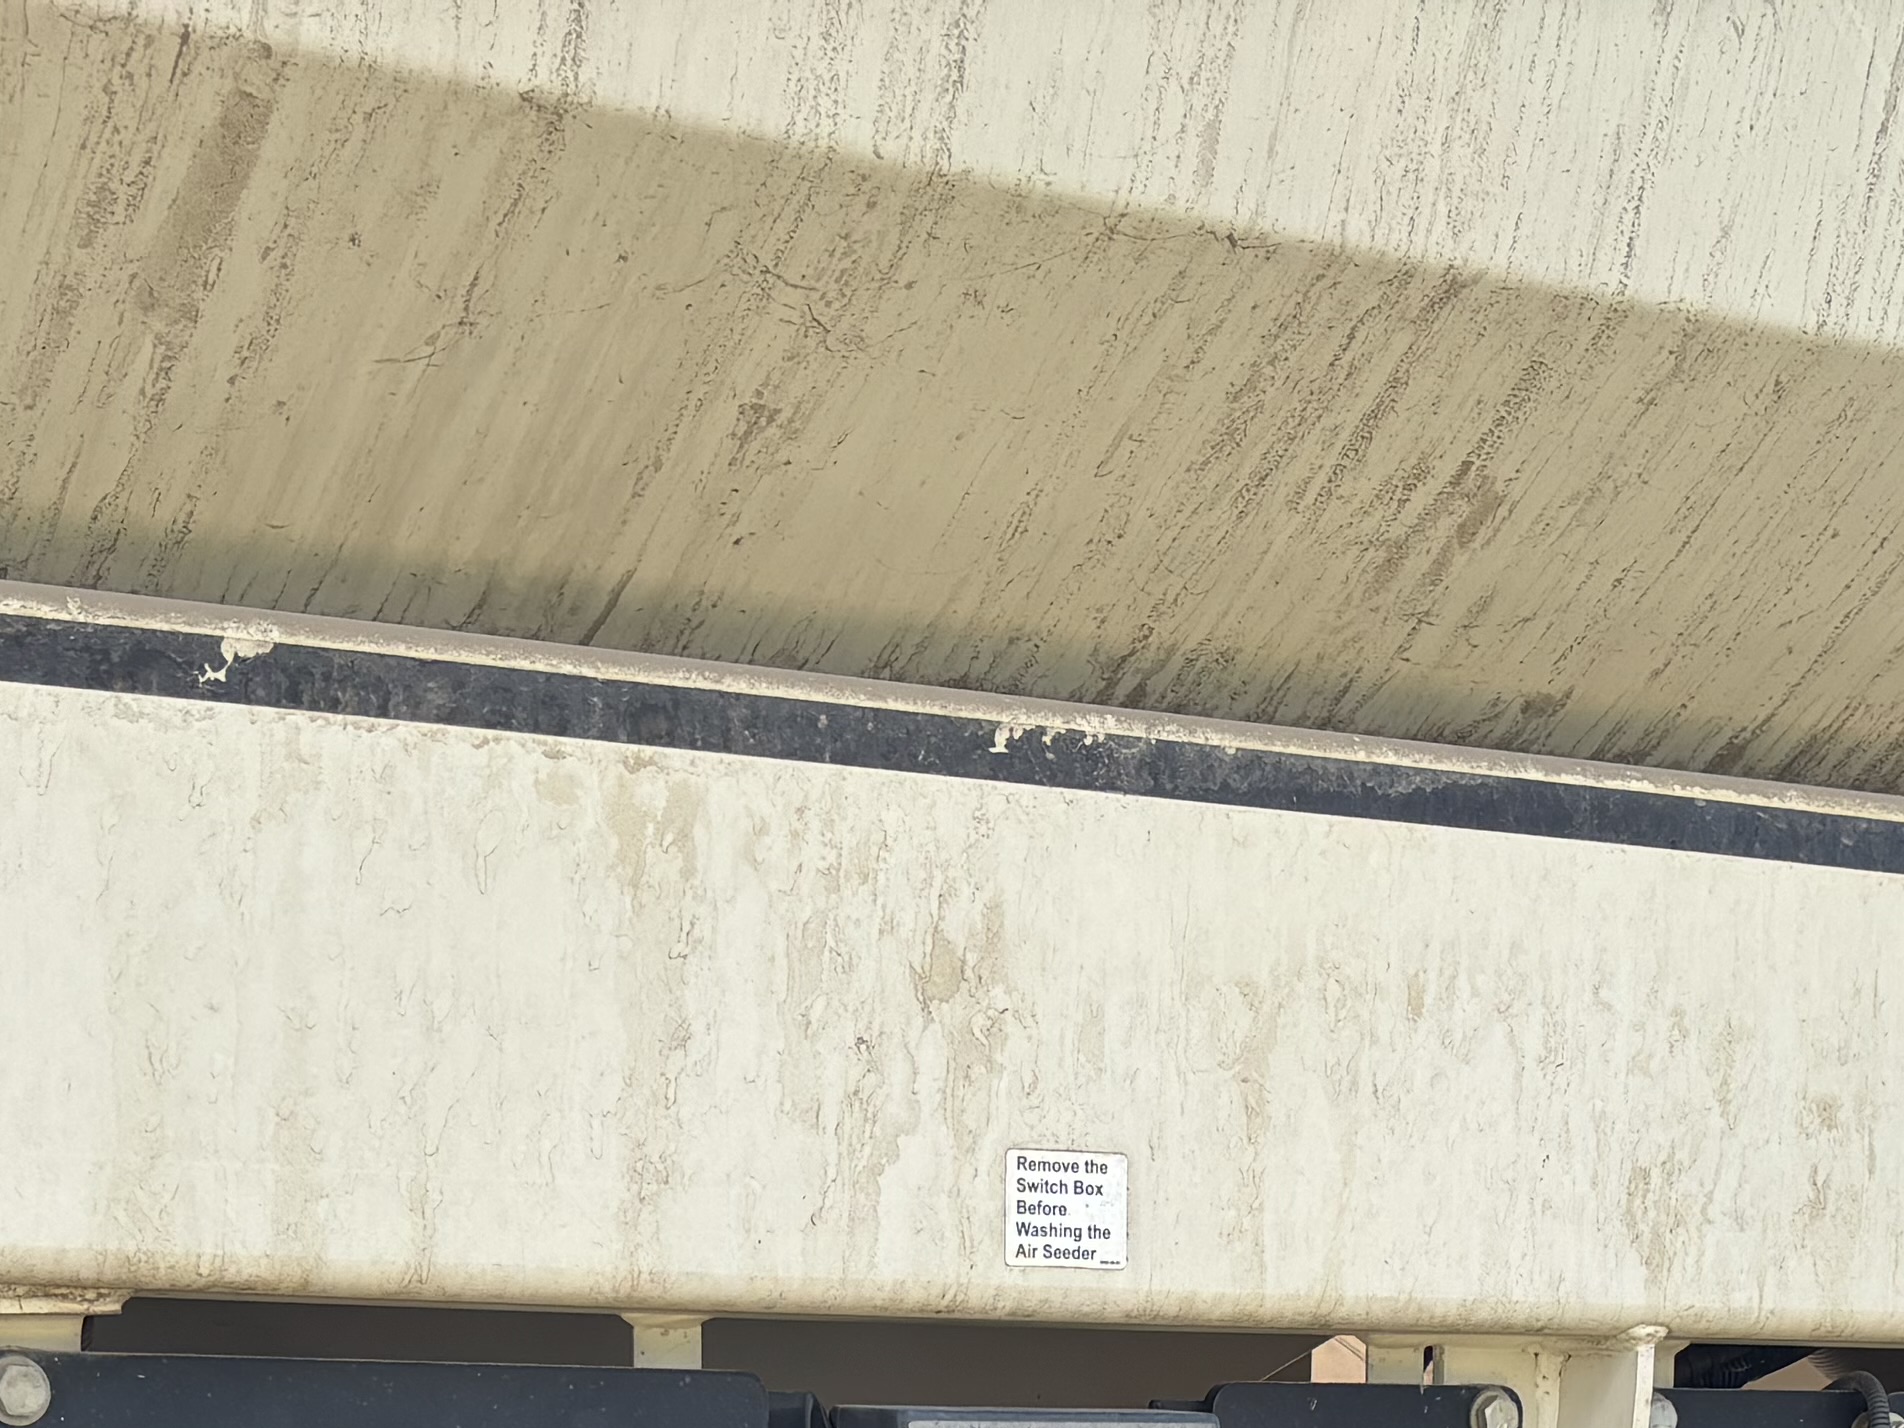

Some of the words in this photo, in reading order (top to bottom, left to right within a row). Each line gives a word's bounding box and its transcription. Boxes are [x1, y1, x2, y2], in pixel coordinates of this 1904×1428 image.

[1017, 1156, 1080, 1174] Remove
[1085, 1160, 1108, 1174] the
[1016, 1177, 1068, 1194] Switch
[1073, 1180, 1104, 1196] Box
[1016, 1200, 1067, 1216] Before
[1016, 1221, 1082, 1242] Washing
[1087, 1224, 1111, 1240] the
[1015, 1244, 1038, 1259] Air
[1043, 1244, 1097, 1260] Seeder
